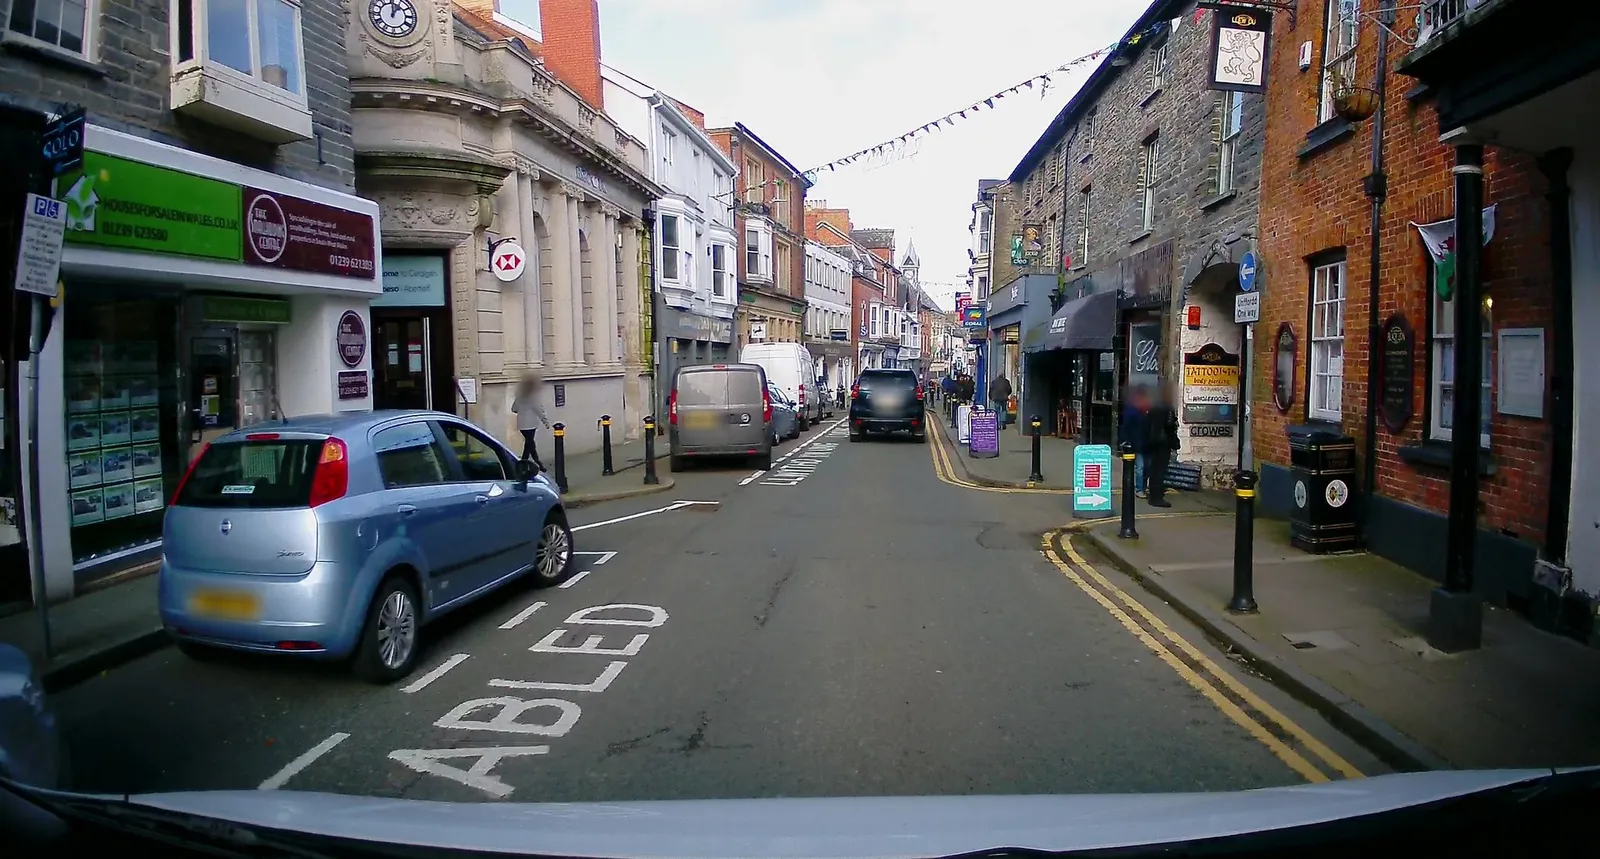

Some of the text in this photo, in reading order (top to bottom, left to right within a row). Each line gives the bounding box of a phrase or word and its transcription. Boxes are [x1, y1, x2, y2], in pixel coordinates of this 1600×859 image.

[329, 254, 350, 269] 01239
[1237, 308, 1257, 318] One way
[1186, 367, 1237, 377] TATTOOISTS
[1190, 426, 1230, 436] crowes
[387, 603, 670, 798] ABLED
